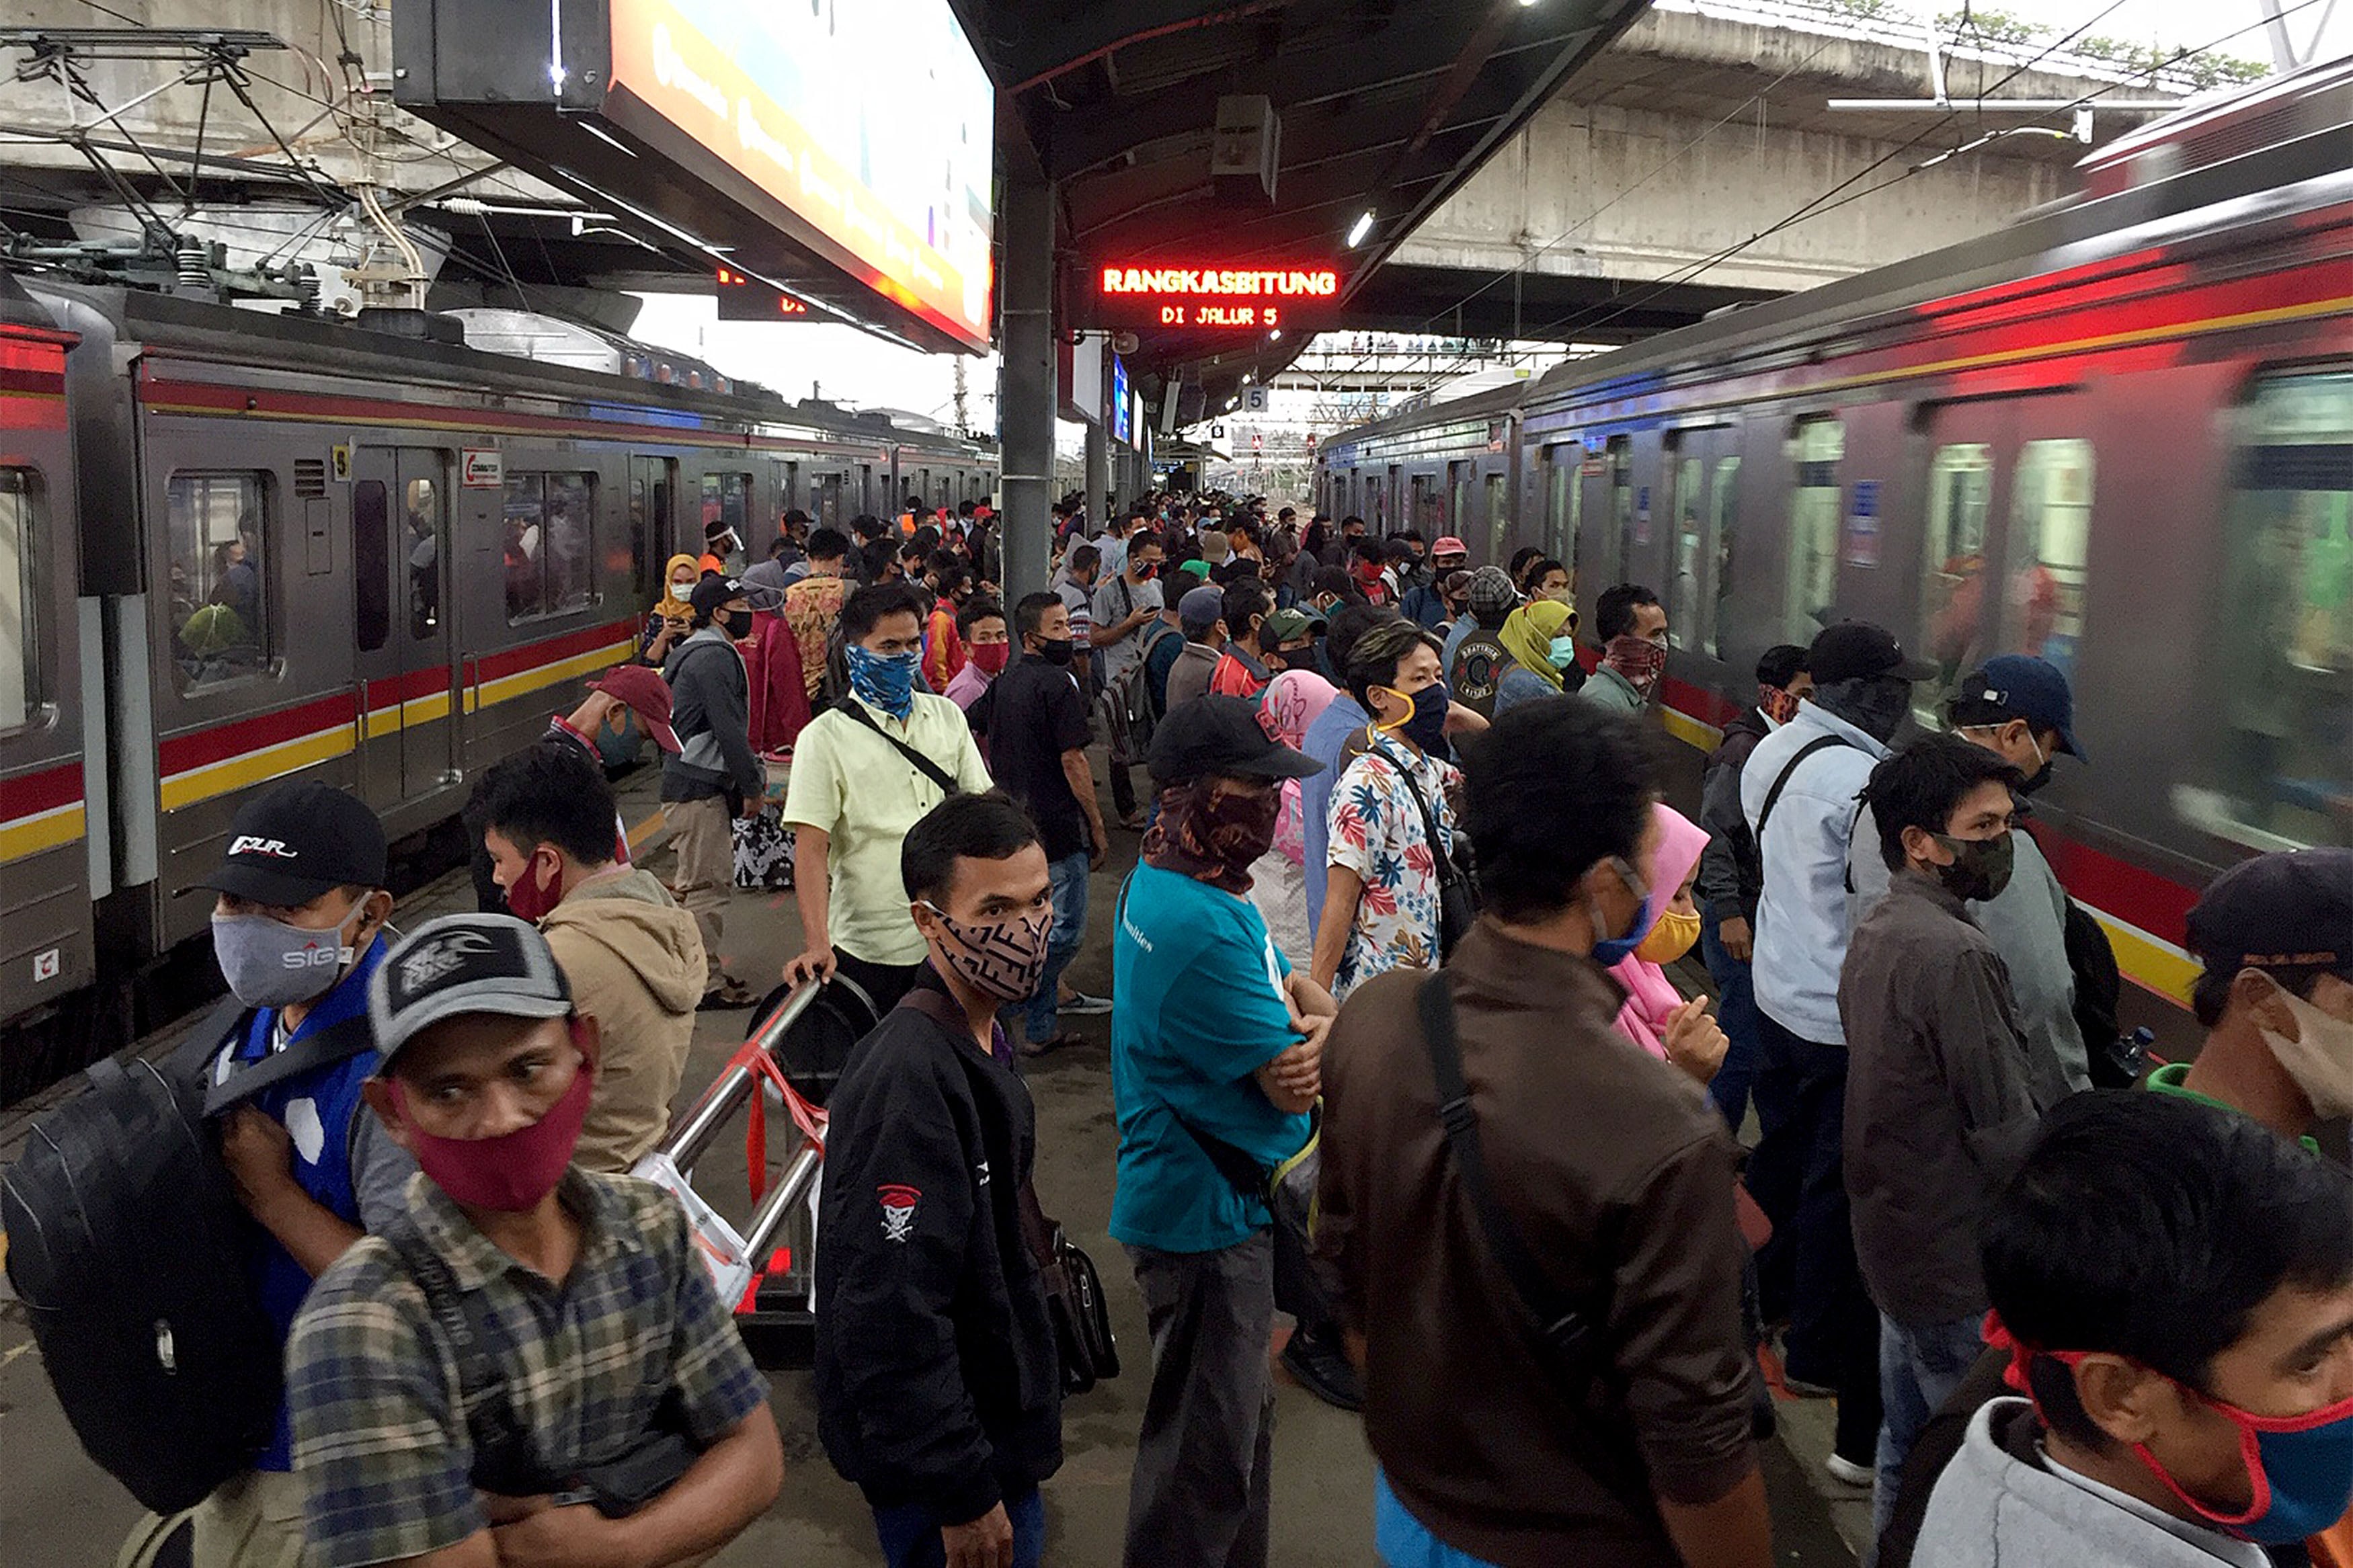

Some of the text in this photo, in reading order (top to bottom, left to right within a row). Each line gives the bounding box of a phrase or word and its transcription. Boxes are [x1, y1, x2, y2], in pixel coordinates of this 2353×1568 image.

[1103, 268, 1336, 295] RANGKASBITUNG
[1162, 306, 1277, 325] DI JALUR 5
[1250, 390, 1262, 408] 5
[282, 946, 335, 969] SIG
